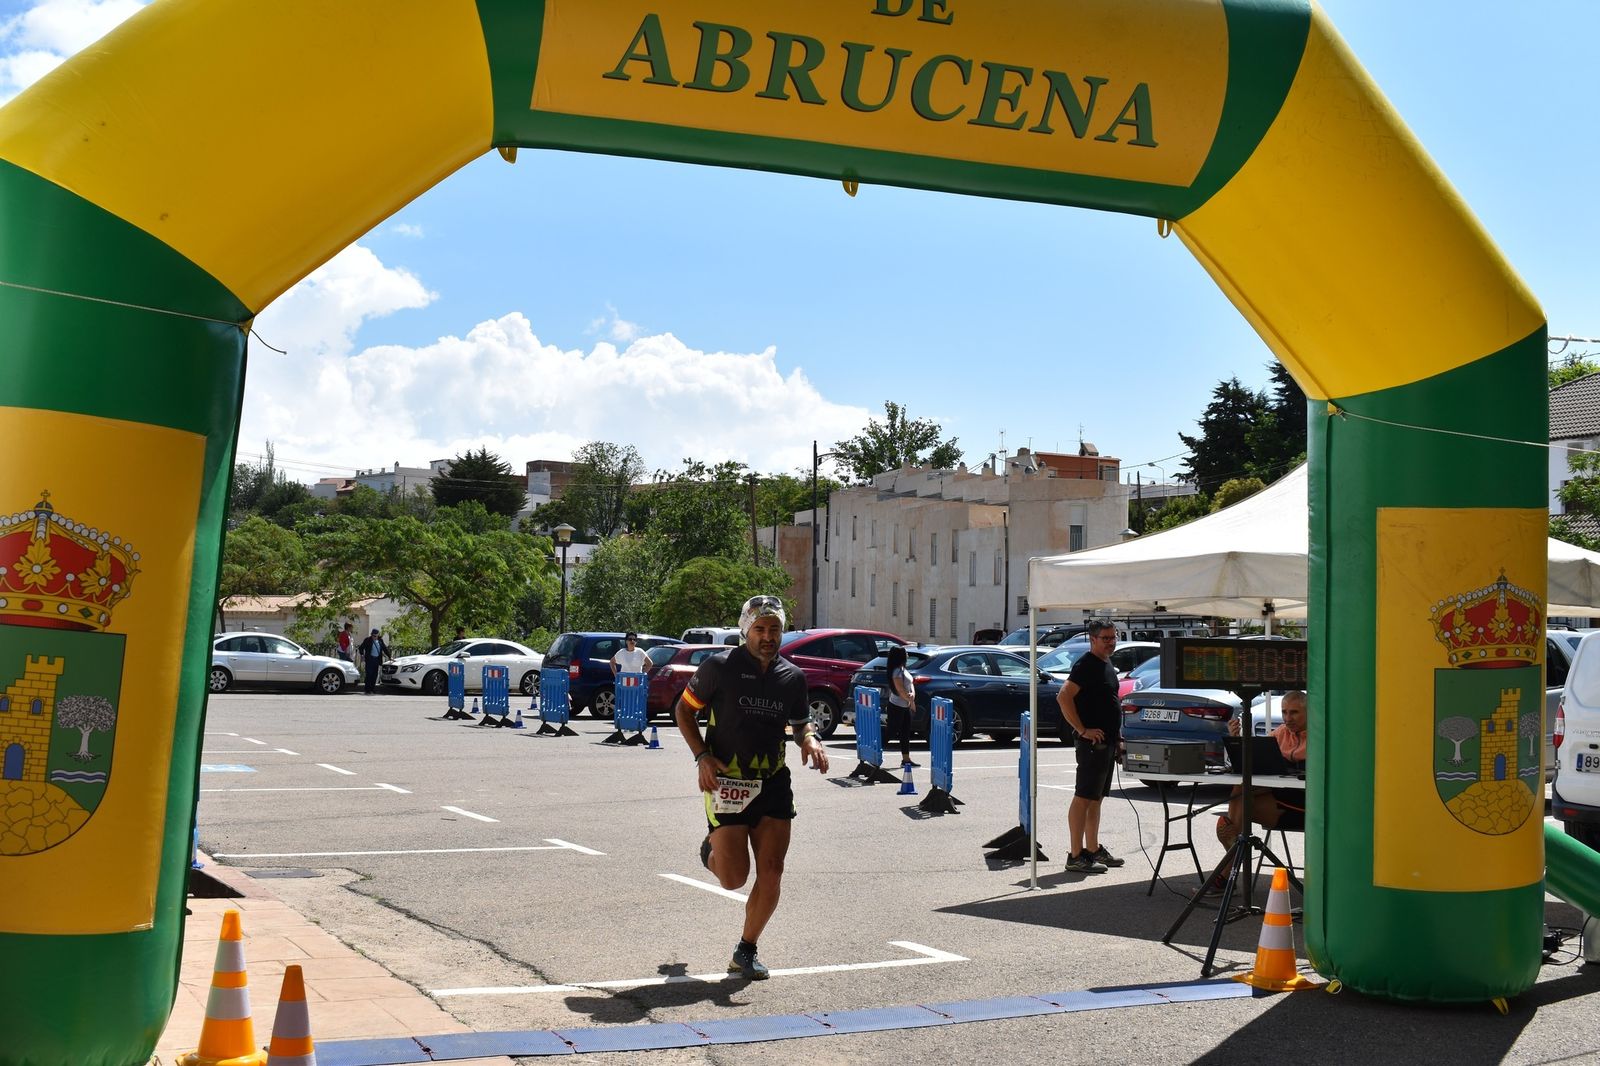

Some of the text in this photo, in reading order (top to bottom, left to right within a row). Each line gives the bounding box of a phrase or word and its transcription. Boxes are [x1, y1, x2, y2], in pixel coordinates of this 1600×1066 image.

[602, 12, 1160, 149] ABRUCENA
[1145, 710, 1178, 720] 9268 JNT
[719, 780, 760, 788] ILENARIA
[720, 787, 750, 800] 508
